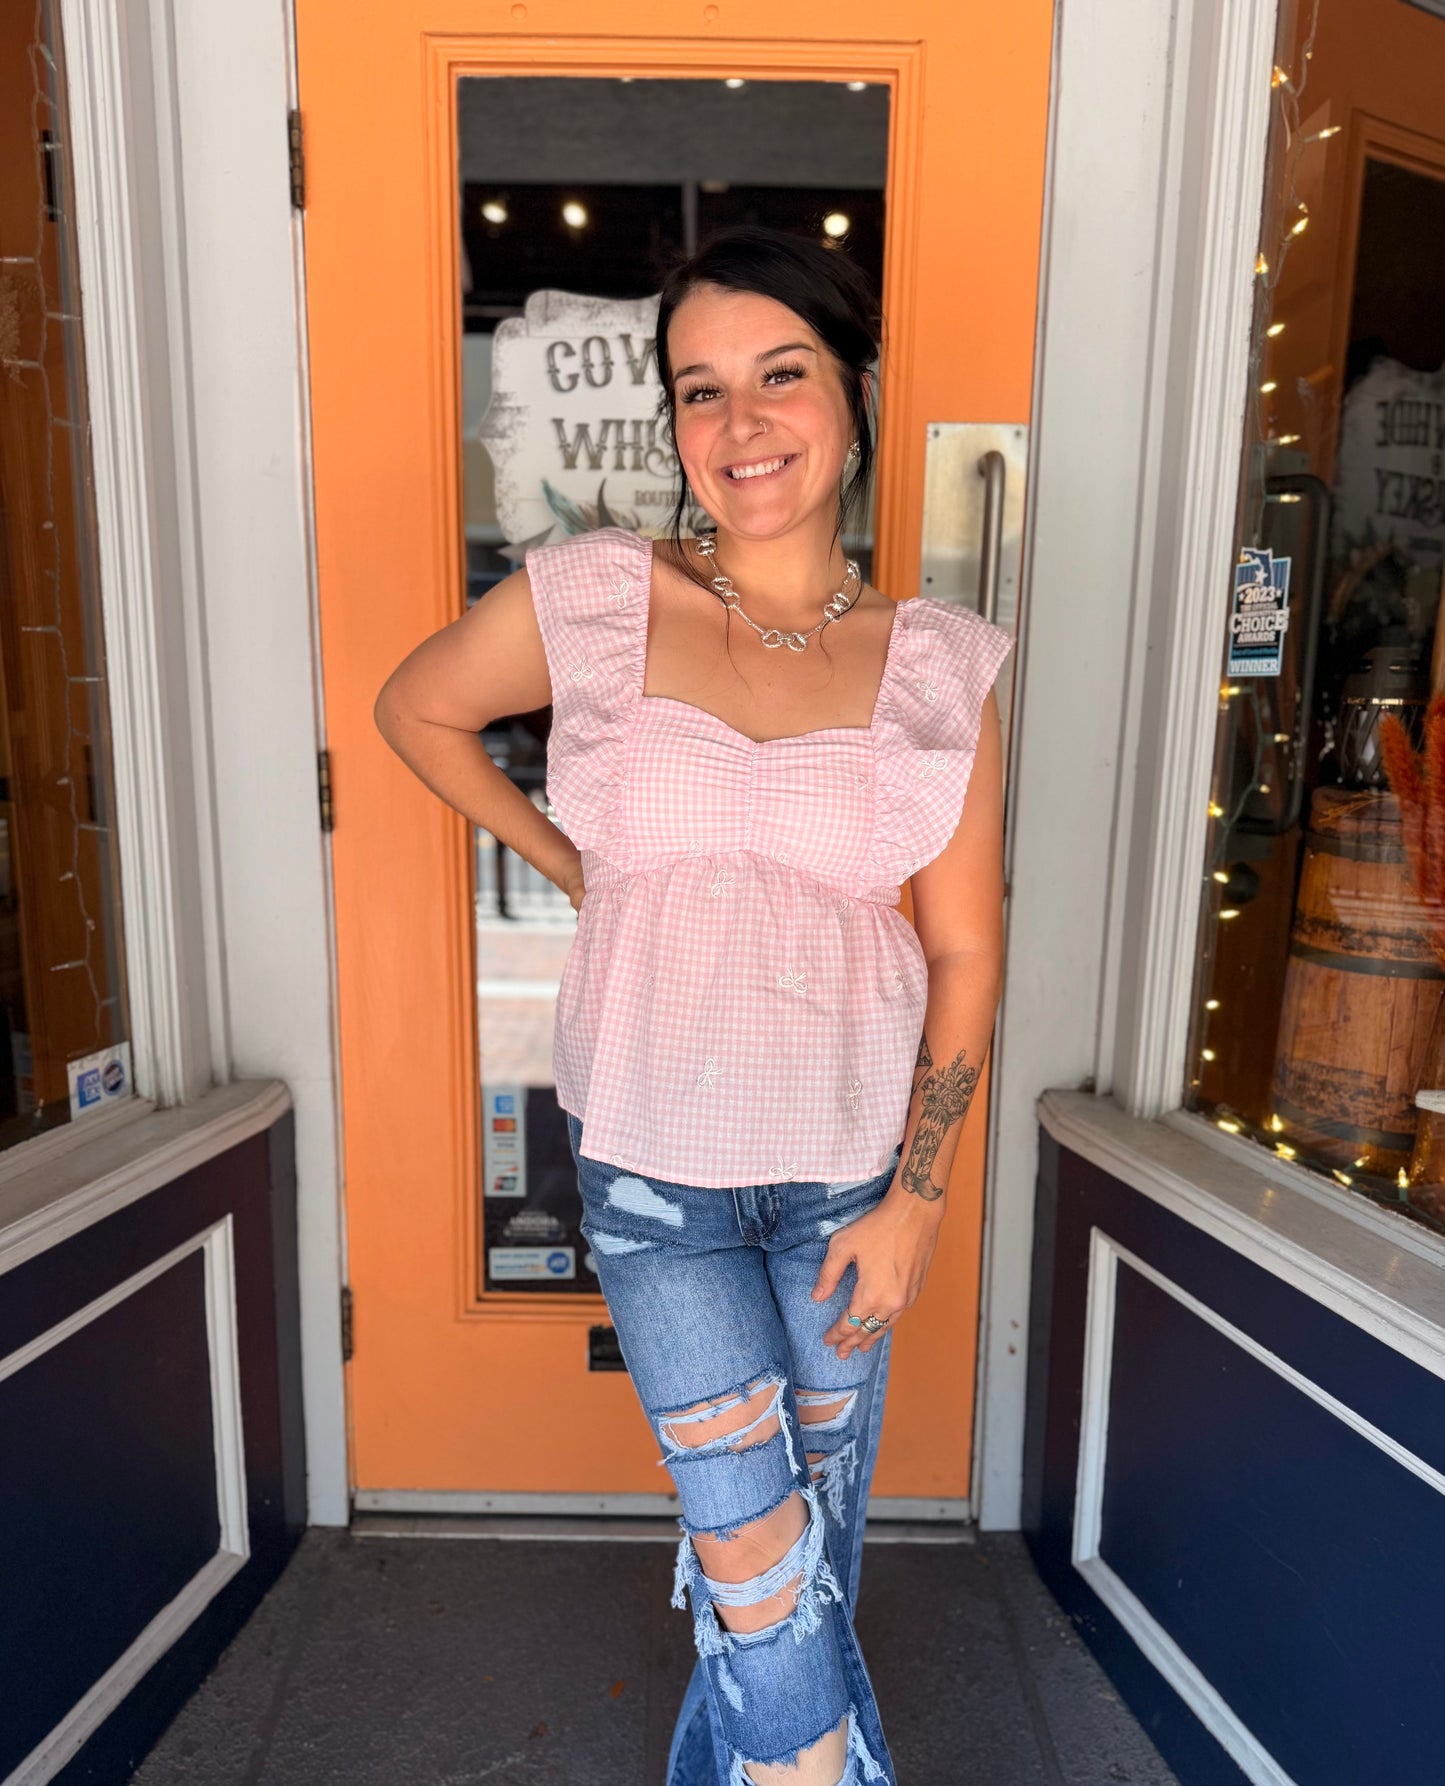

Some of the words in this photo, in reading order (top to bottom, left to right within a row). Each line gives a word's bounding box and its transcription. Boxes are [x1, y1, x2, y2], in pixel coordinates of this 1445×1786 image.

[546, 333, 660, 393] COW
[1244, 586, 1276, 604] 2023
[1230, 609, 1287, 634] CHOICE
[1237, 631, 1276, 644] AWARDS
[1230, 659, 1278, 673] WINNER
